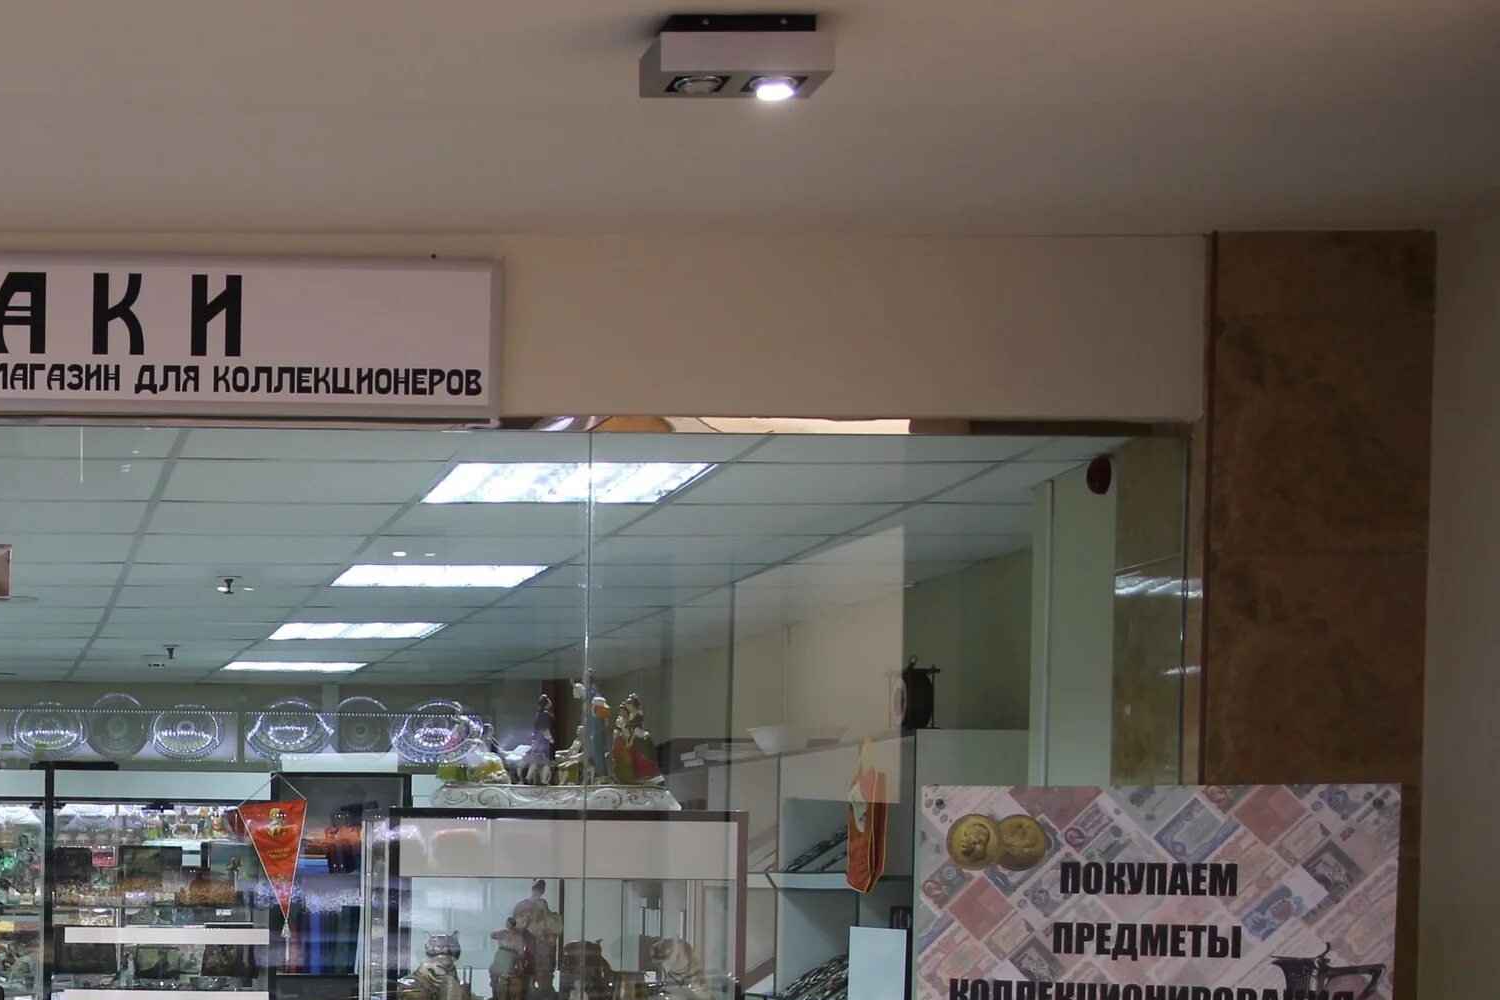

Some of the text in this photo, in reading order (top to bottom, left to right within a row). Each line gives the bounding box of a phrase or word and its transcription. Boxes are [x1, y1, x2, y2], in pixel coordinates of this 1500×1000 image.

[134, 365, 200, 394] ДЛЯ
[212, 366, 483, 397] КОЛЛЕКЦИОНЕРОВ
[1059, 861, 1239, 897] ПОКУПАЕМ
[1052, 921, 1243, 962] ПРЕДМЕТЫ
